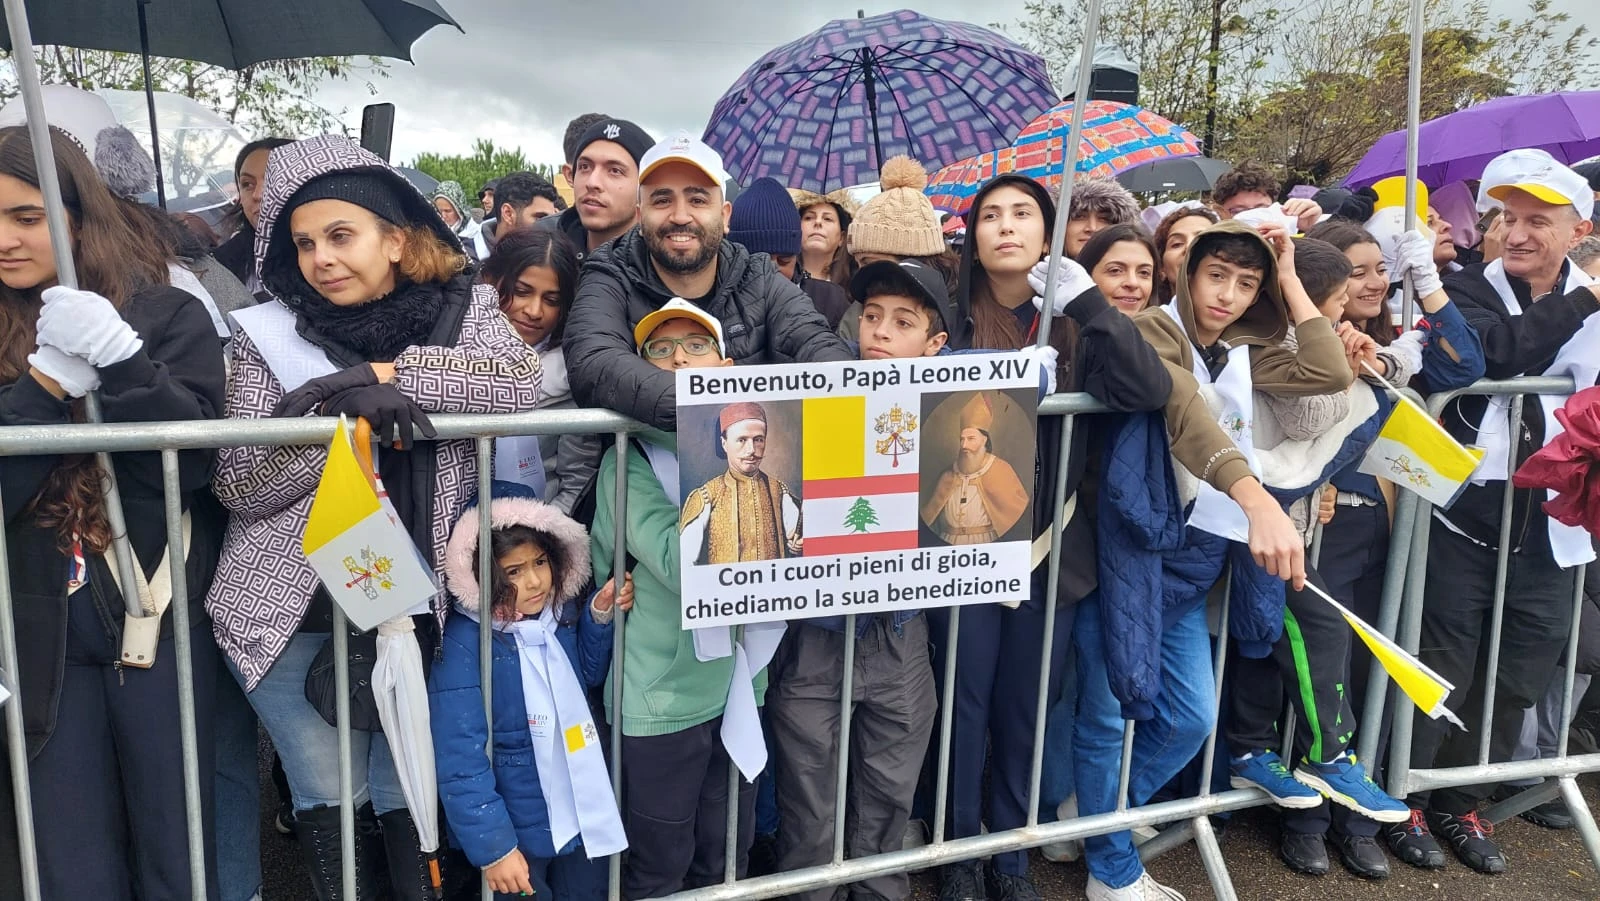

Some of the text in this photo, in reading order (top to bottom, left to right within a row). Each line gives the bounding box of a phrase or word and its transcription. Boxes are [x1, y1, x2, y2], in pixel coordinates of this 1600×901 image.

[690, 359, 1030, 395] Benvenuto, Papà Leone XIV
[719, 549, 997, 586] Con i cuori pieni di gioia,
[686, 577, 1021, 619] chiediamo la sua benedizione
